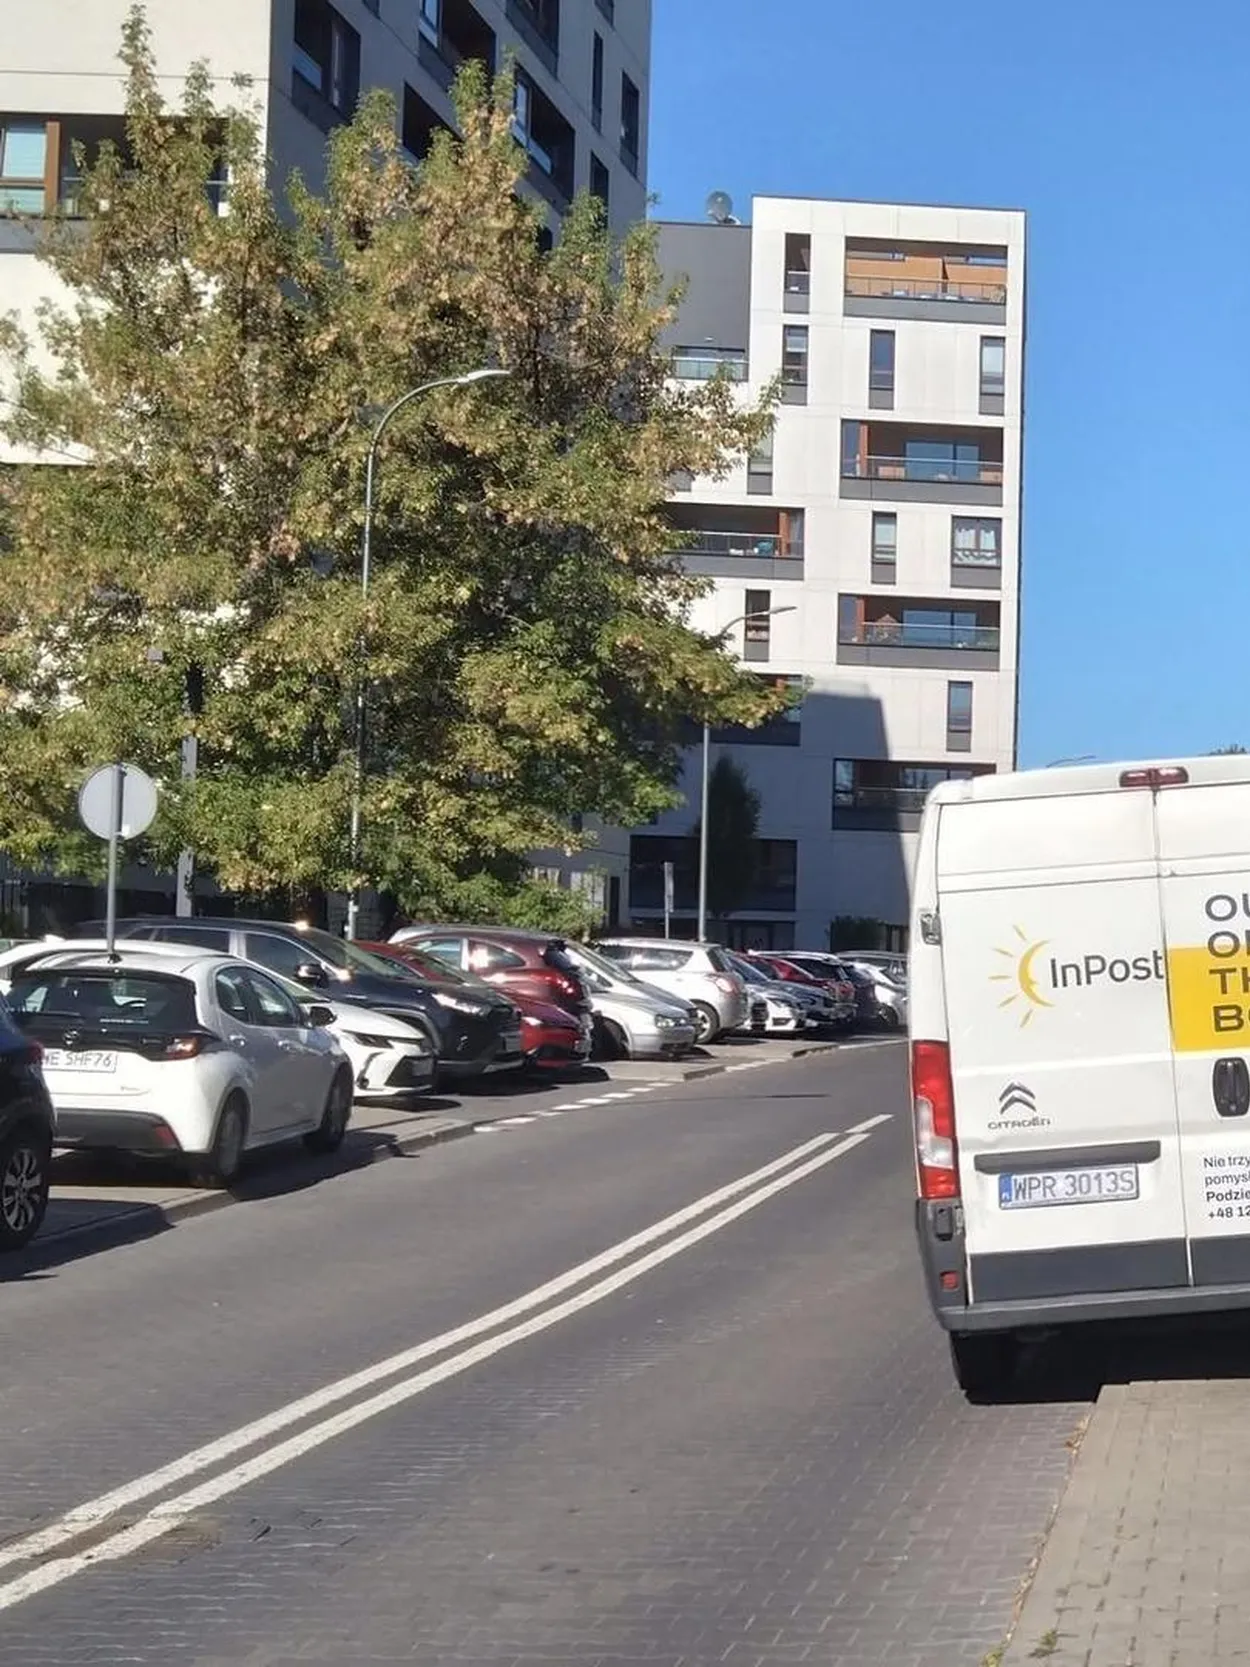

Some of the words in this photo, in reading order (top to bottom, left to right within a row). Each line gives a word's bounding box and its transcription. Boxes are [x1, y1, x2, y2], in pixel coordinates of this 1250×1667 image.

[1050, 950, 1164, 988] InPost
[1203, 1156, 1226, 1168] Nie
[1014, 1175, 1056, 1200] WPR
[1209, 1207, 1233, 1219] +48
